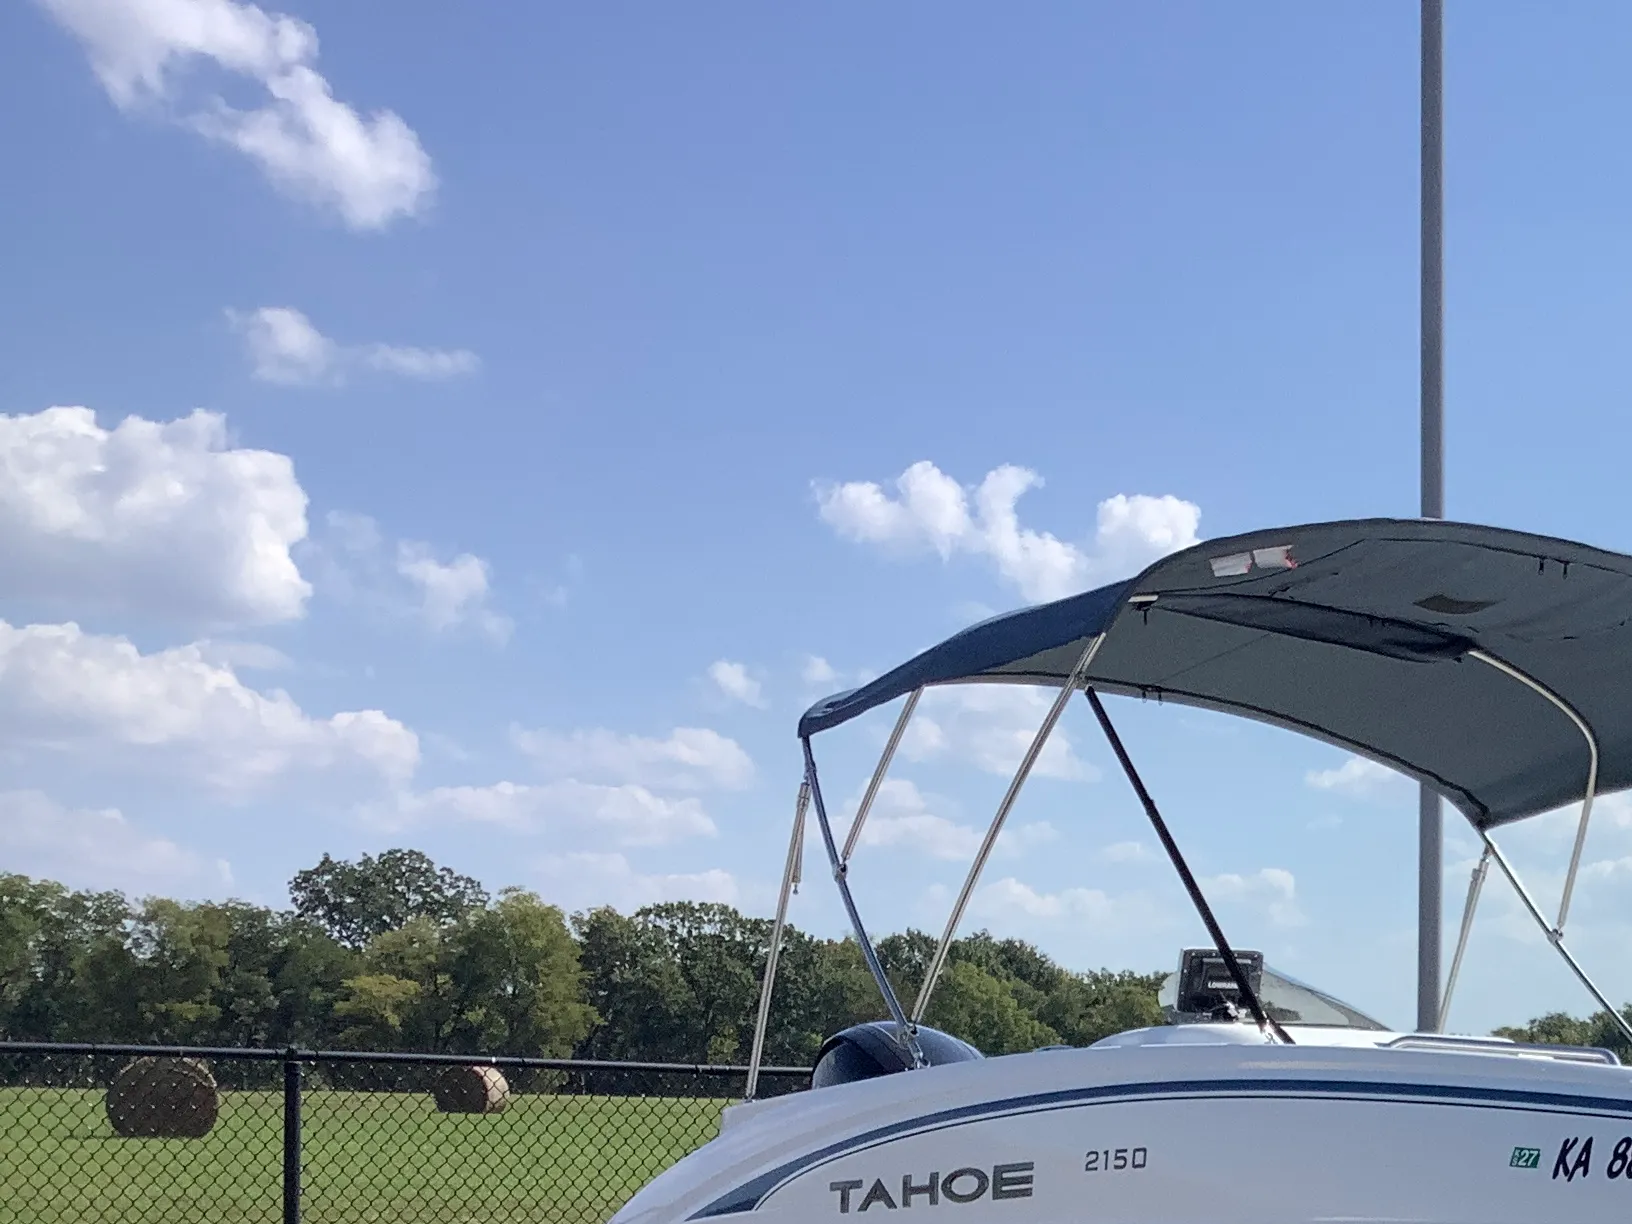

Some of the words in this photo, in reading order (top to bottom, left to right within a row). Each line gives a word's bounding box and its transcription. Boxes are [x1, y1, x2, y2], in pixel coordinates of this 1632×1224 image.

[1084, 1147, 1148, 1172] 2150
[1518, 1149, 1539, 1167] 27
[1551, 1136, 1594, 1183] KA
[829, 1161, 1035, 1214] TAHOE
